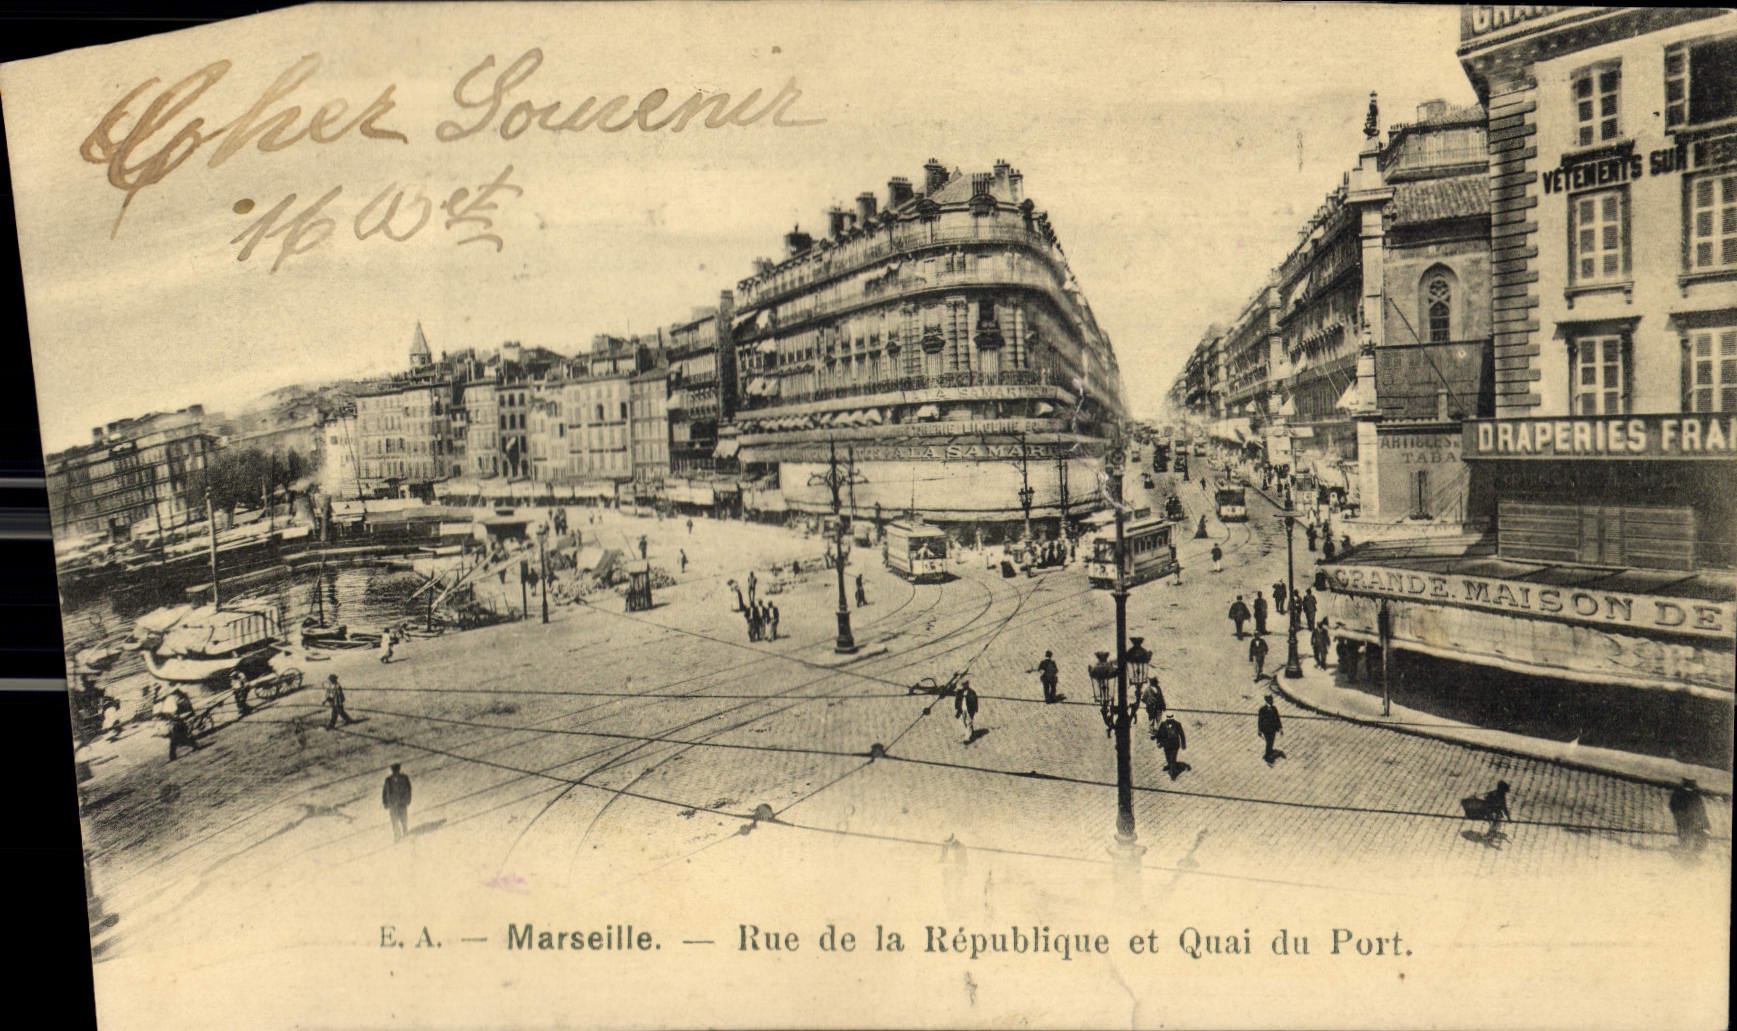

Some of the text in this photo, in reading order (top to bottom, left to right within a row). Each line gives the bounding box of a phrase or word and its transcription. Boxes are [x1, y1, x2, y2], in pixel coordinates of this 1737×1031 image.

[1478, 419, 1647, 452] DRAPERIES
[1401, 452, 1457, 464] TABA
[1462, 578, 1633, 622] MAISON
[1654, 600, 1723, 631] DE
